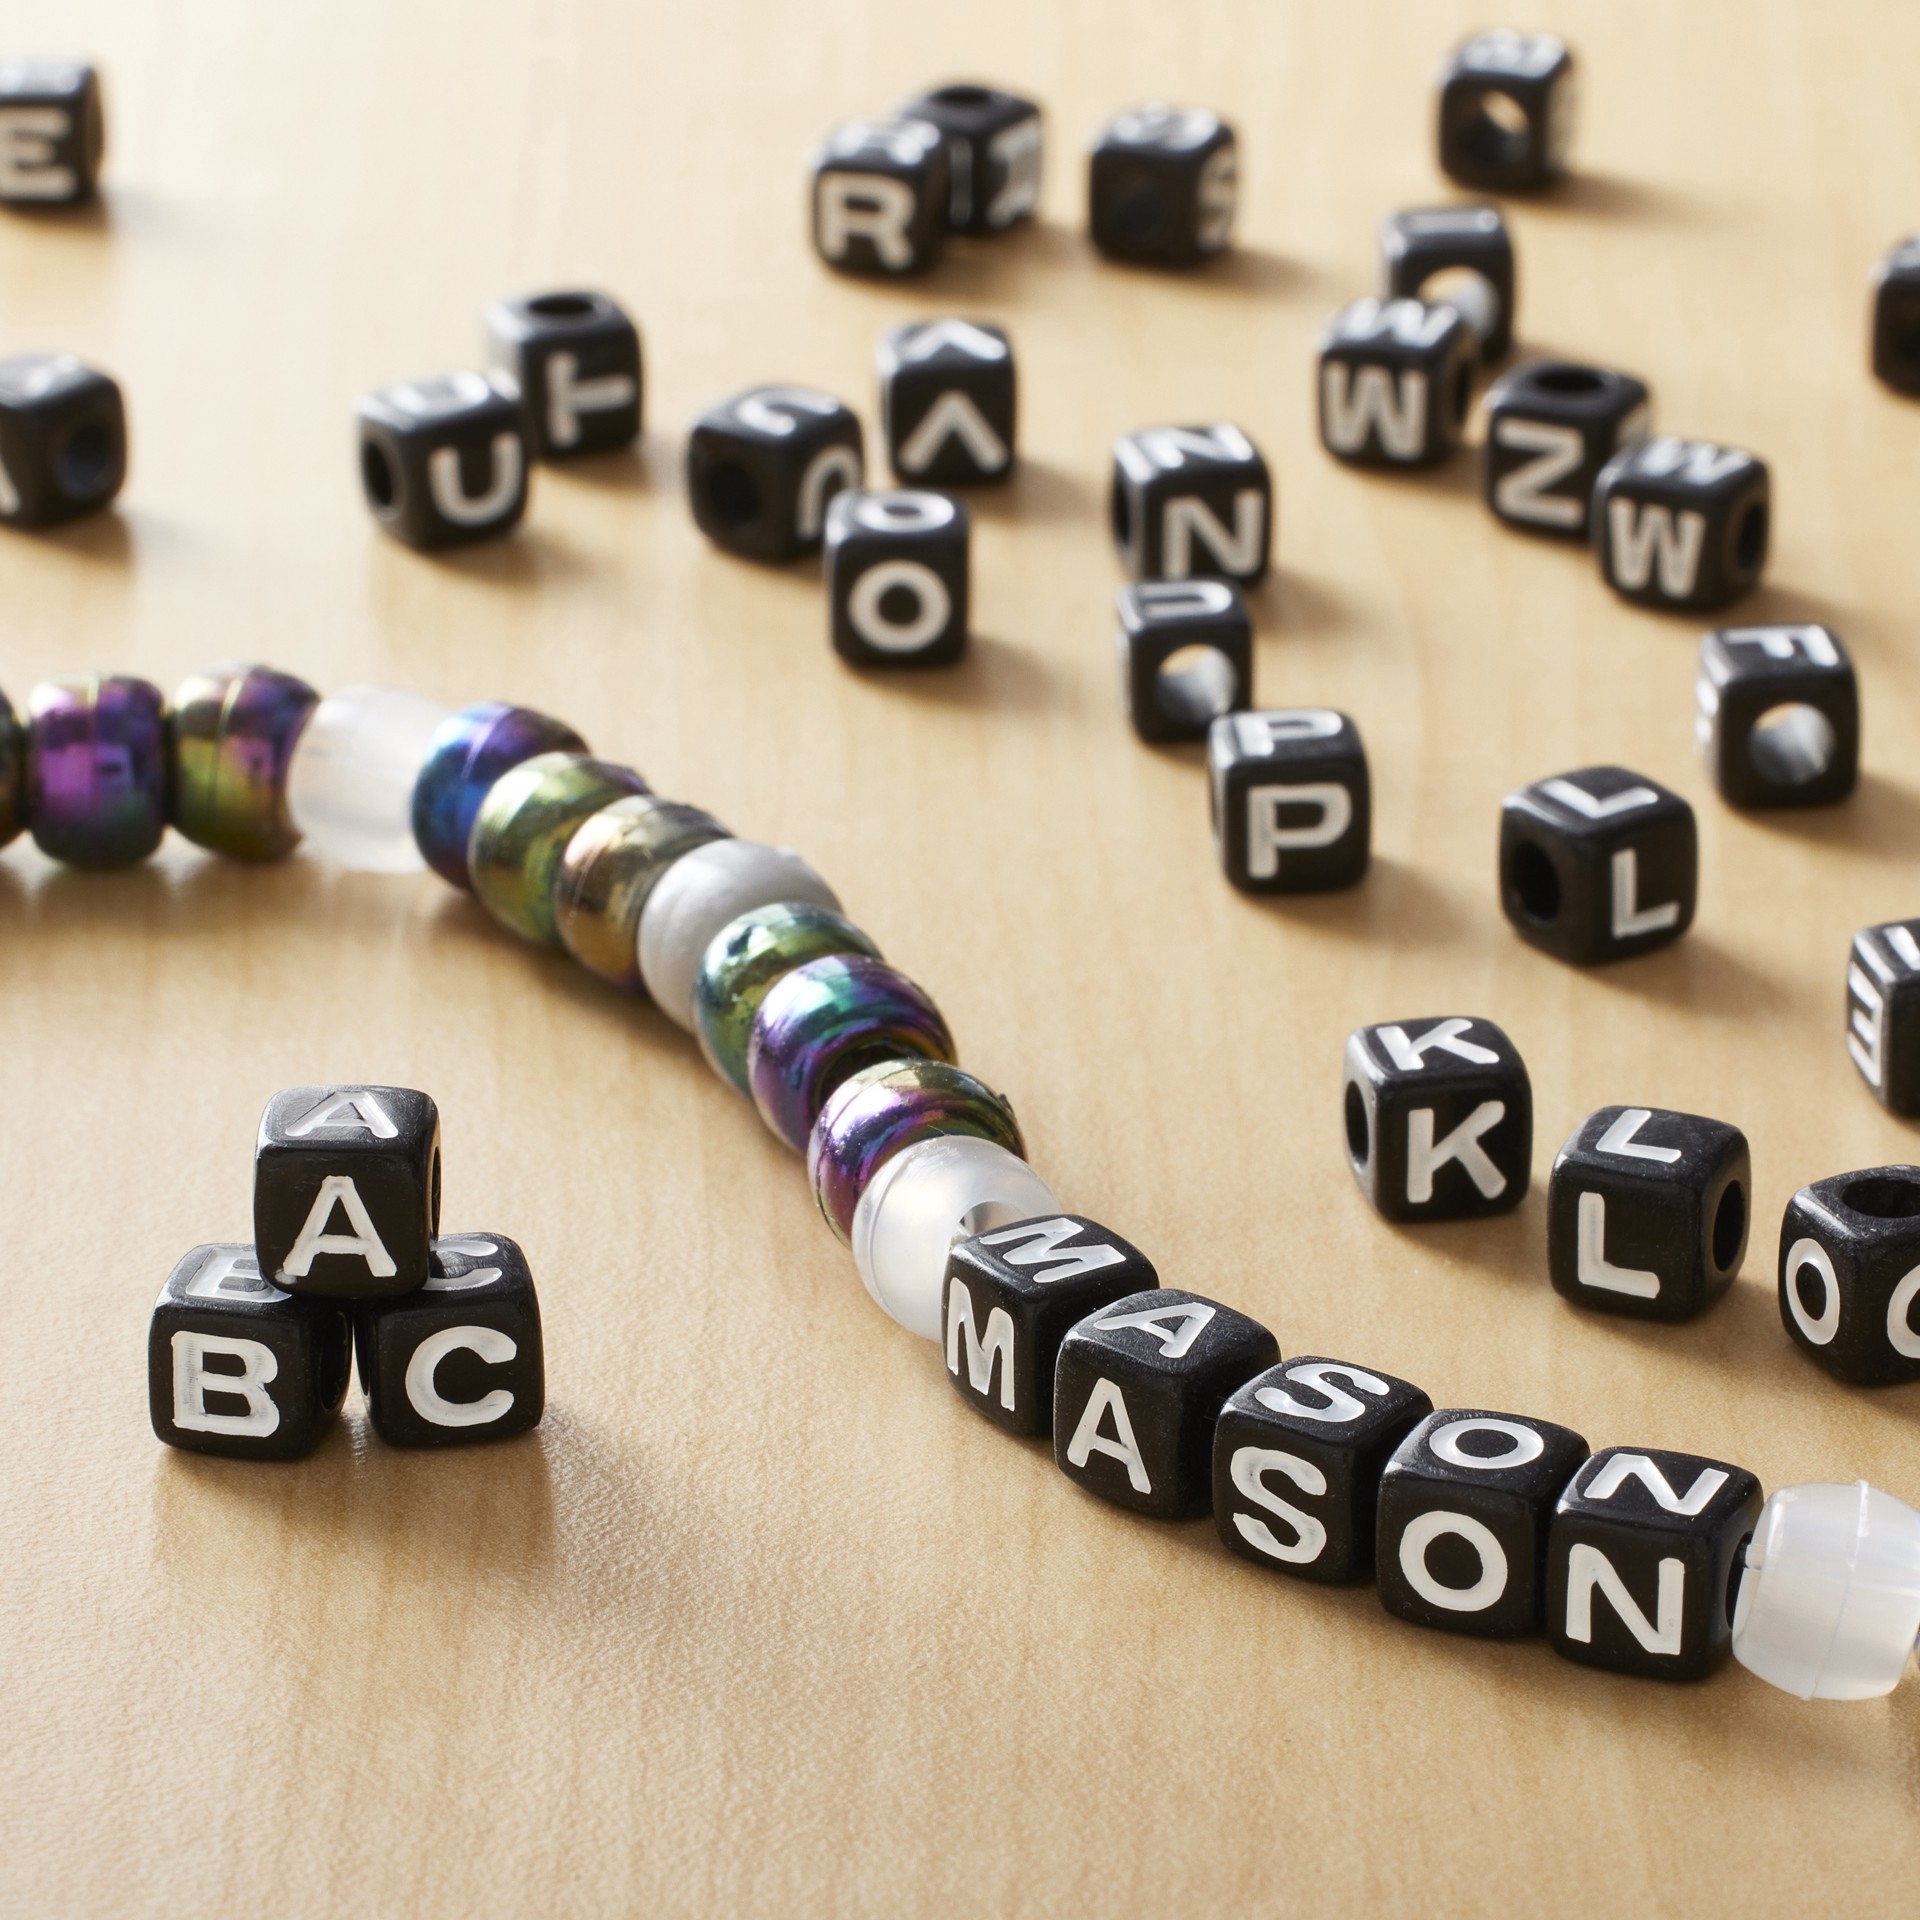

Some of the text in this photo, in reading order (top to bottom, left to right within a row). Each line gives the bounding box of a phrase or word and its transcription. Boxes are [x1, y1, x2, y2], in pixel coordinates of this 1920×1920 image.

[818, 170, 915, 270] R
[429, 433, 523, 526] U
[1161, 489, 1264, 578] N
[1608, 497, 1707, 598] W
[849, 560, 949, 652] O
[1236, 711, 1342, 757] P
[1247, 782, 1351, 879] P
[1540, 778, 1658, 819] L
[1610, 847, 1680, 939] L
[1376, 1018, 1500, 1070] K
[285, 1090, 399, 1139] A
[1407, 1100, 1507, 1203] K
[1595, 1108, 1682, 1163] L
[282, 1175, 398, 1278] A
[1577, 1191, 1661, 1299] L
[1785, 1237, 1841, 1345] O
[171, 1330, 280, 1438] B
[404, 1325, 517, 1427] C
